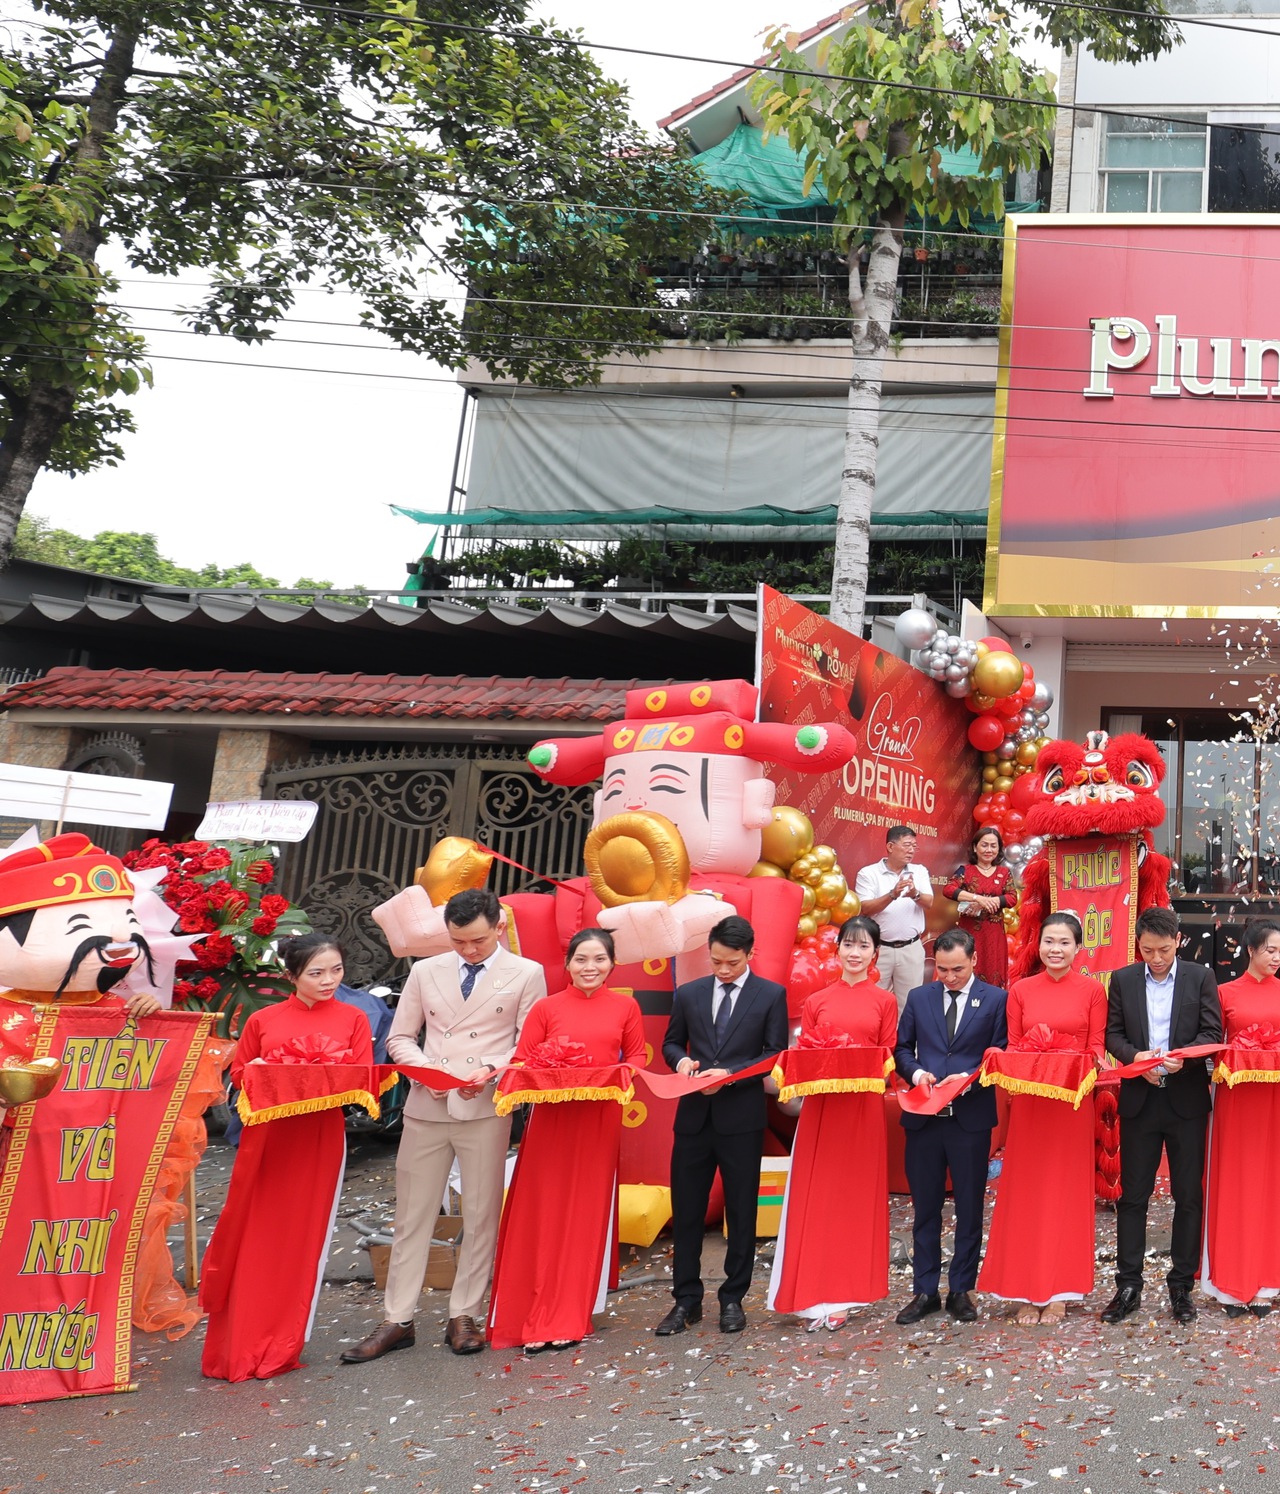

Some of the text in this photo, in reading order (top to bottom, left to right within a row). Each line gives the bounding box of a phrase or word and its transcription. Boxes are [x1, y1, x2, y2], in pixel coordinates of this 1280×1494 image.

[775, 626, 813, 659] Plumeria
[827, 655, 854, 682] ROYAL
[843, 755, 935, 814] OPENING
[834, 806, 865, 824] PLUMERIA
[866, 812, 877, 826] SPA
[877, 815, 885, 827] BY
[919, 824, 938, 838] DƯƠNG
[1062, 844, 1122, 890] PHÚC
[1081, 903, 1113, 958] ỘC
[61, 1017, 168, 1091] TIỀN
[58, 1114, 116, 1182] VÔ
[18, 1209, 118, 1276] NHƯ
[0, 1299, 98, 1372] NƯỚC
